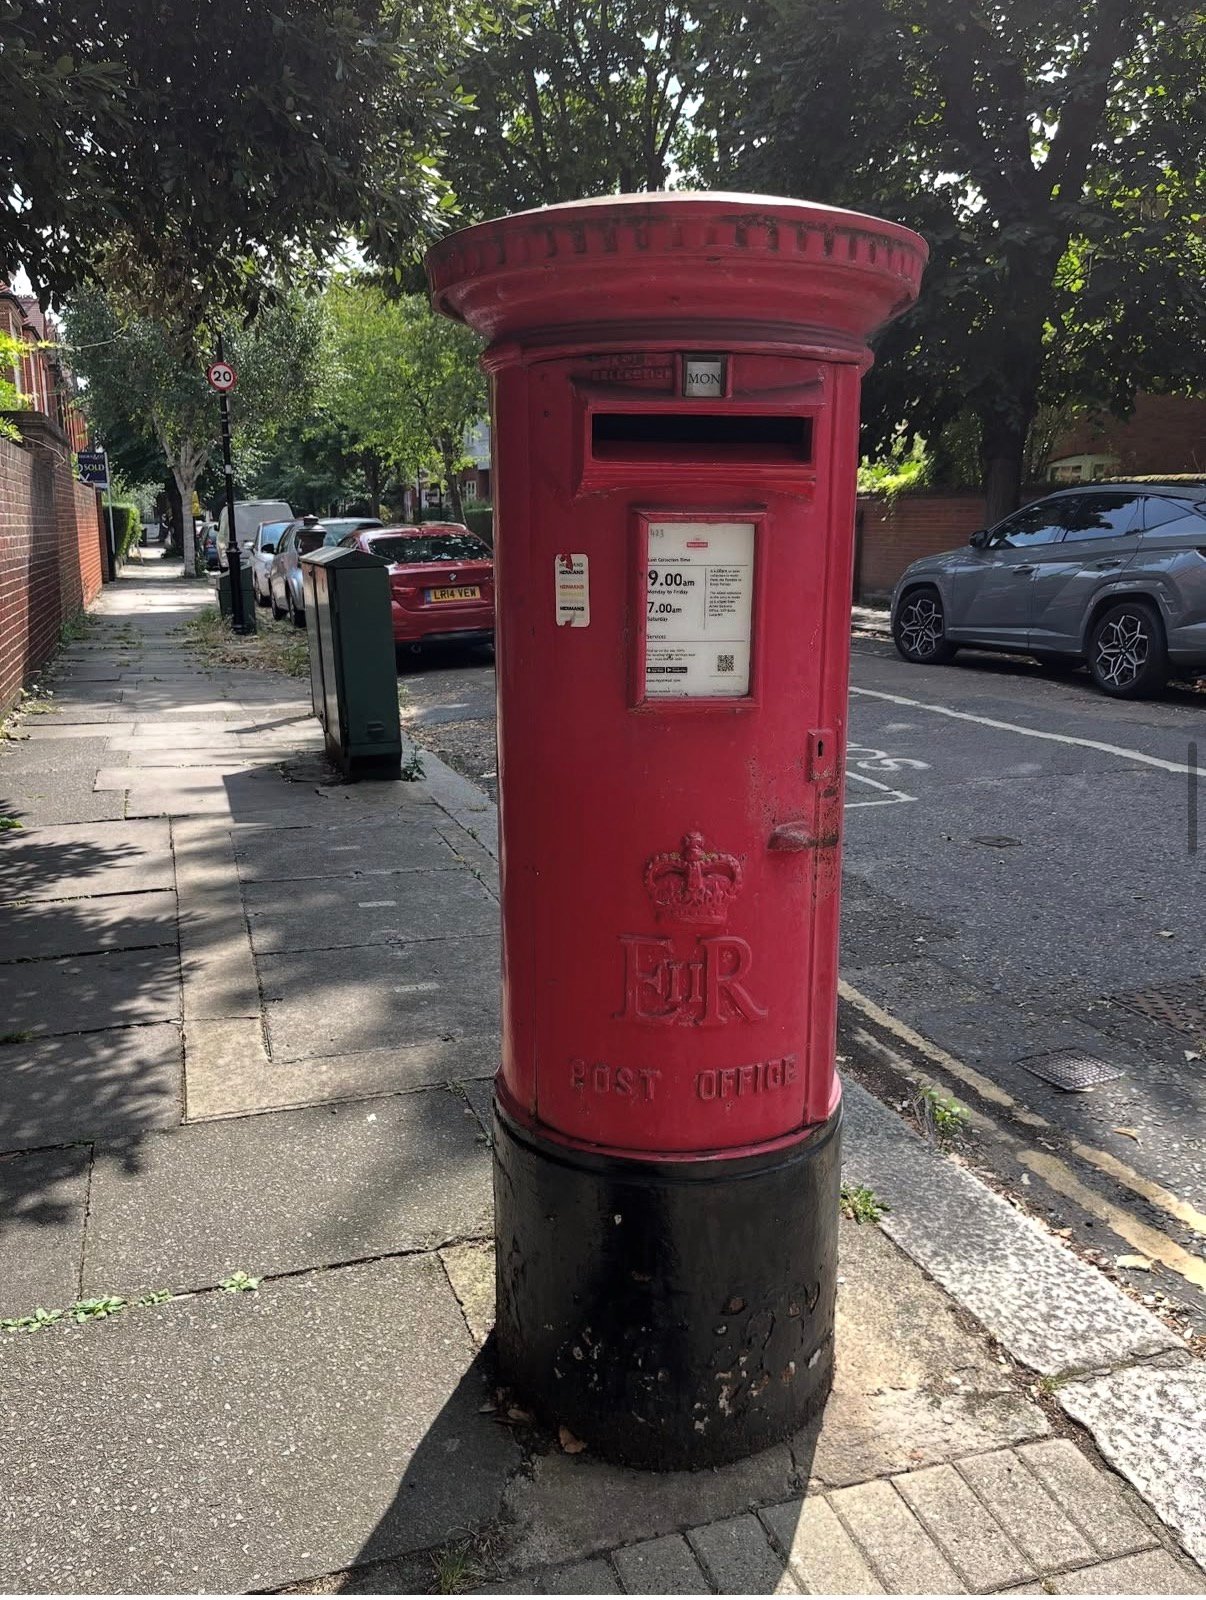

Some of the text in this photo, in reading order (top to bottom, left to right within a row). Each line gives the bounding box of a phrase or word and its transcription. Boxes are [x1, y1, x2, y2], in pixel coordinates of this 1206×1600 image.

[213, 370, 232, 382] 20
[687, 373, 720, 384] MON
[83, 463, 105, 472] SOLD
[648, 569, 695, 587] 9.00am
[433, 586, 477, 600] LR14 VEW
[647, 601, 682, 614] 7.00am
[570, 1053, 799, 1101] POST OFFICE
